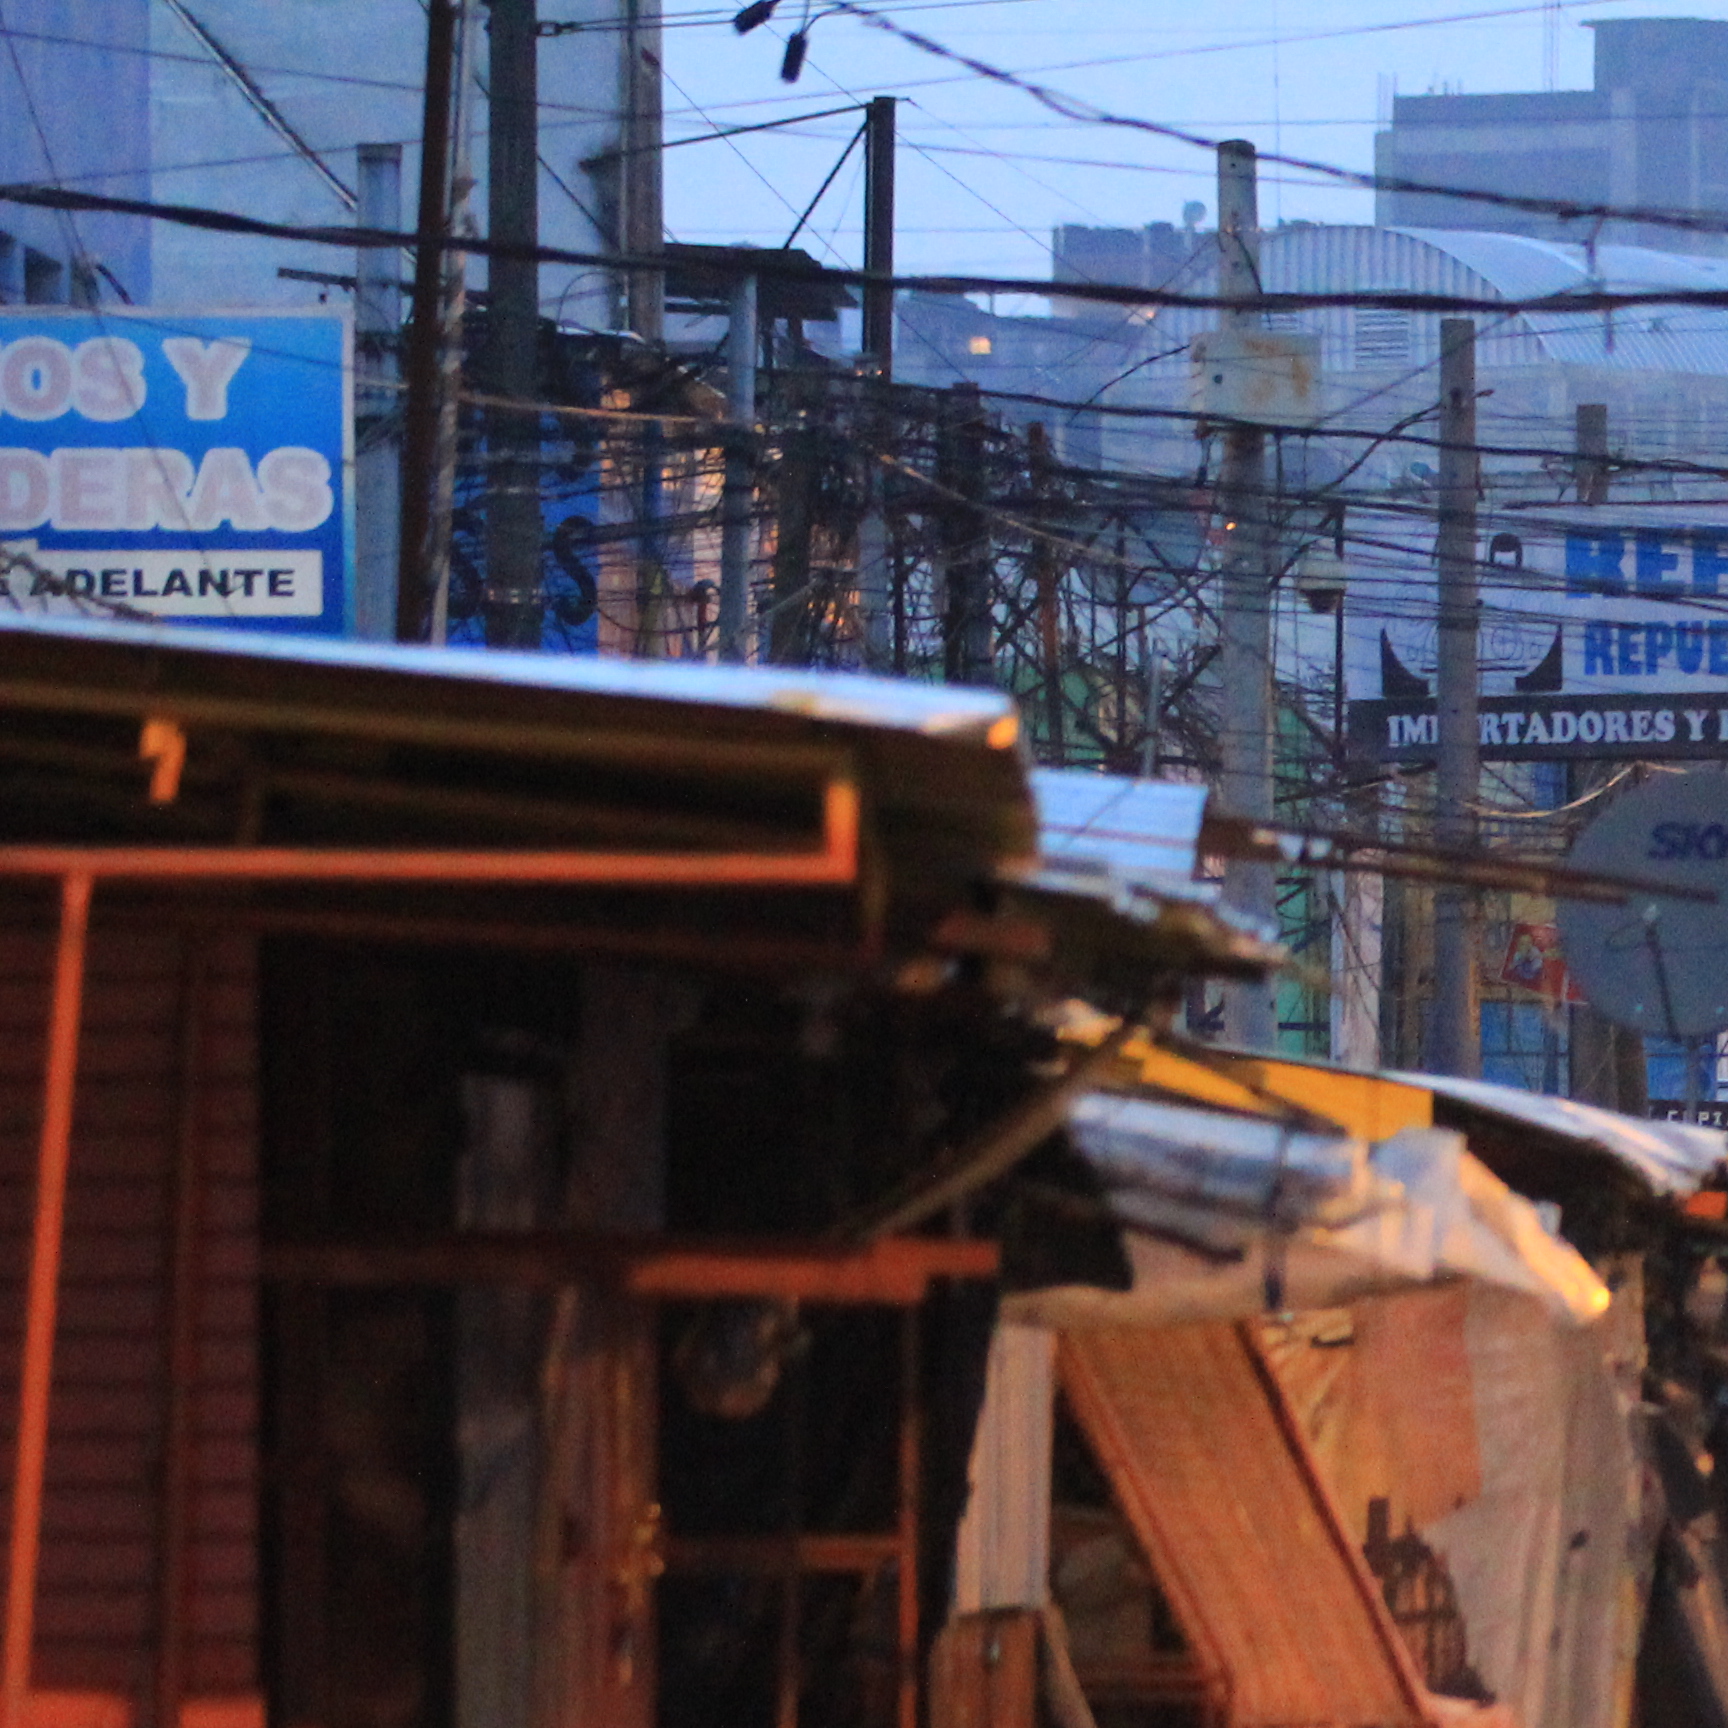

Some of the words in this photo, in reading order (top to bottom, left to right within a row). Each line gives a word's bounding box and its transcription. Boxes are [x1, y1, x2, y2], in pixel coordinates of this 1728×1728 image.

[161, 337, 250, 421] Y
[30, 569, 296, 598] ADELANTE
[1386, 709, 1676, 748] IMRTADORES
[1681, 710, 1706, 742] Y
